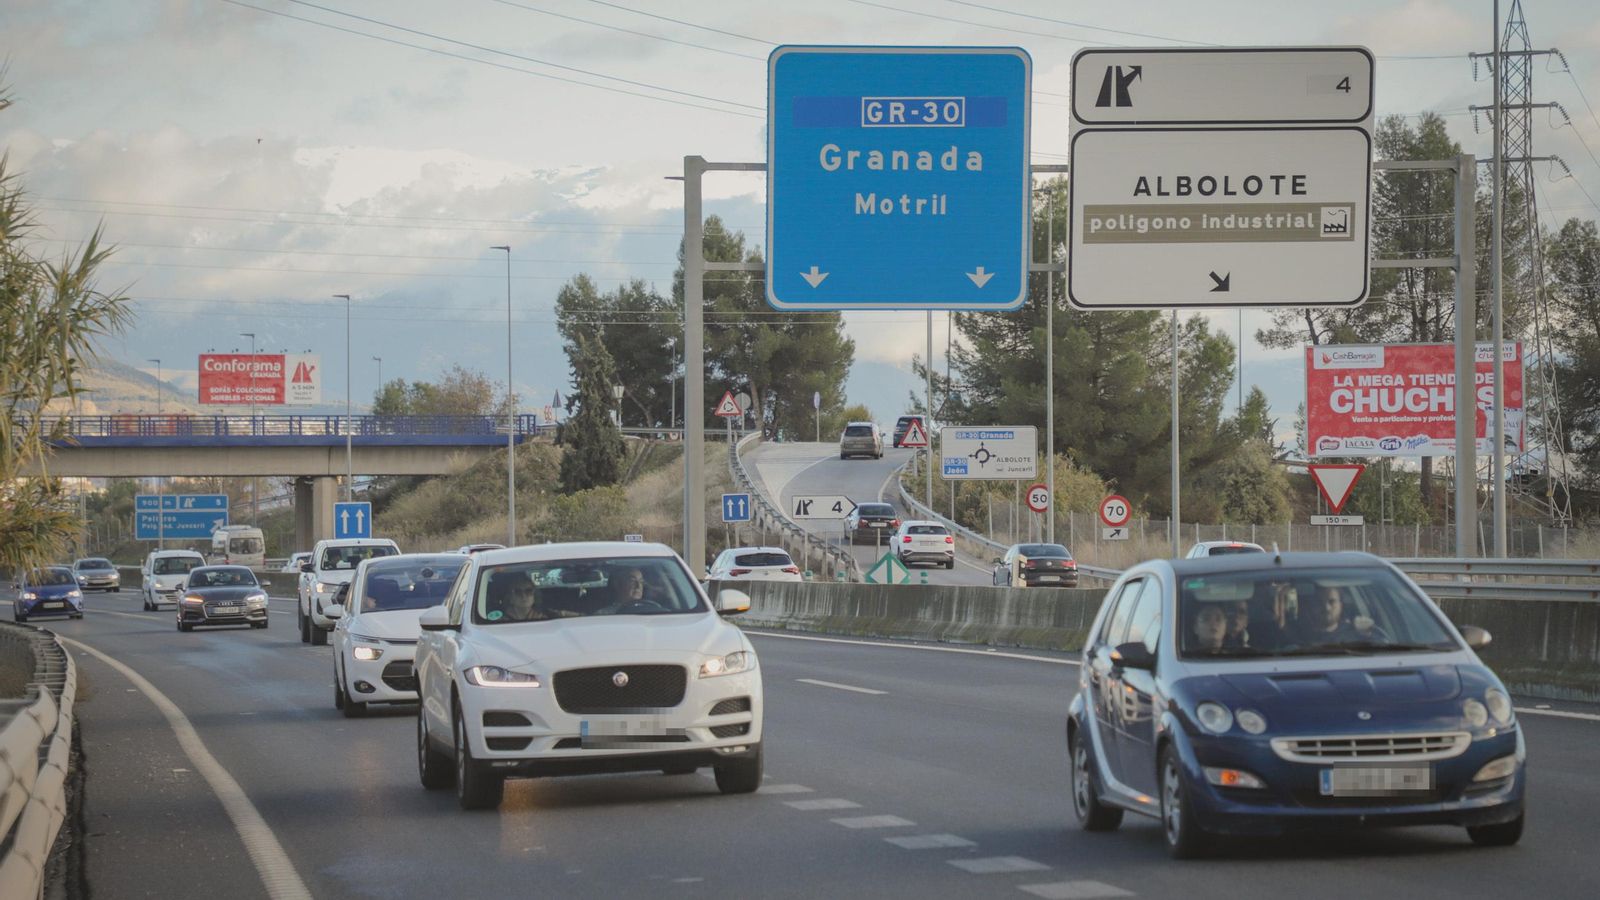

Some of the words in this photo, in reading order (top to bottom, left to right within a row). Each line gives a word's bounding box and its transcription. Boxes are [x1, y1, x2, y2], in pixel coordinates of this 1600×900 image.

[1335, 76, 1351, 94] 4
[866, 101, 960, 124] GR-30
[819, 143, 984, 171] Granada
[1133, 174, 1307, 197] ALBOLOTE
[854, 192, 947, 216] Motril
[1202, 212, 1314, 230] industrial
[204, 358, 281, 372] Conforama
[1333, 376, 1354, 387] LA
[1358, 375, 1405, 387] MEGA
[1408, 373, 1456, 386] TIEND
[1475, 373, 1494, 385] DE
[1330, 386, 1494, 413] CHUCHS
[1352, 416, 1372, 424] Venta
[1379, 415, 1421, 425] particulares
[1344, 440, 1374, 449] LACASA
[1032, 494, 1047, 503] 50
[832, 502, 843, 513] 4
[1106, 505, 1125, 516] 70
